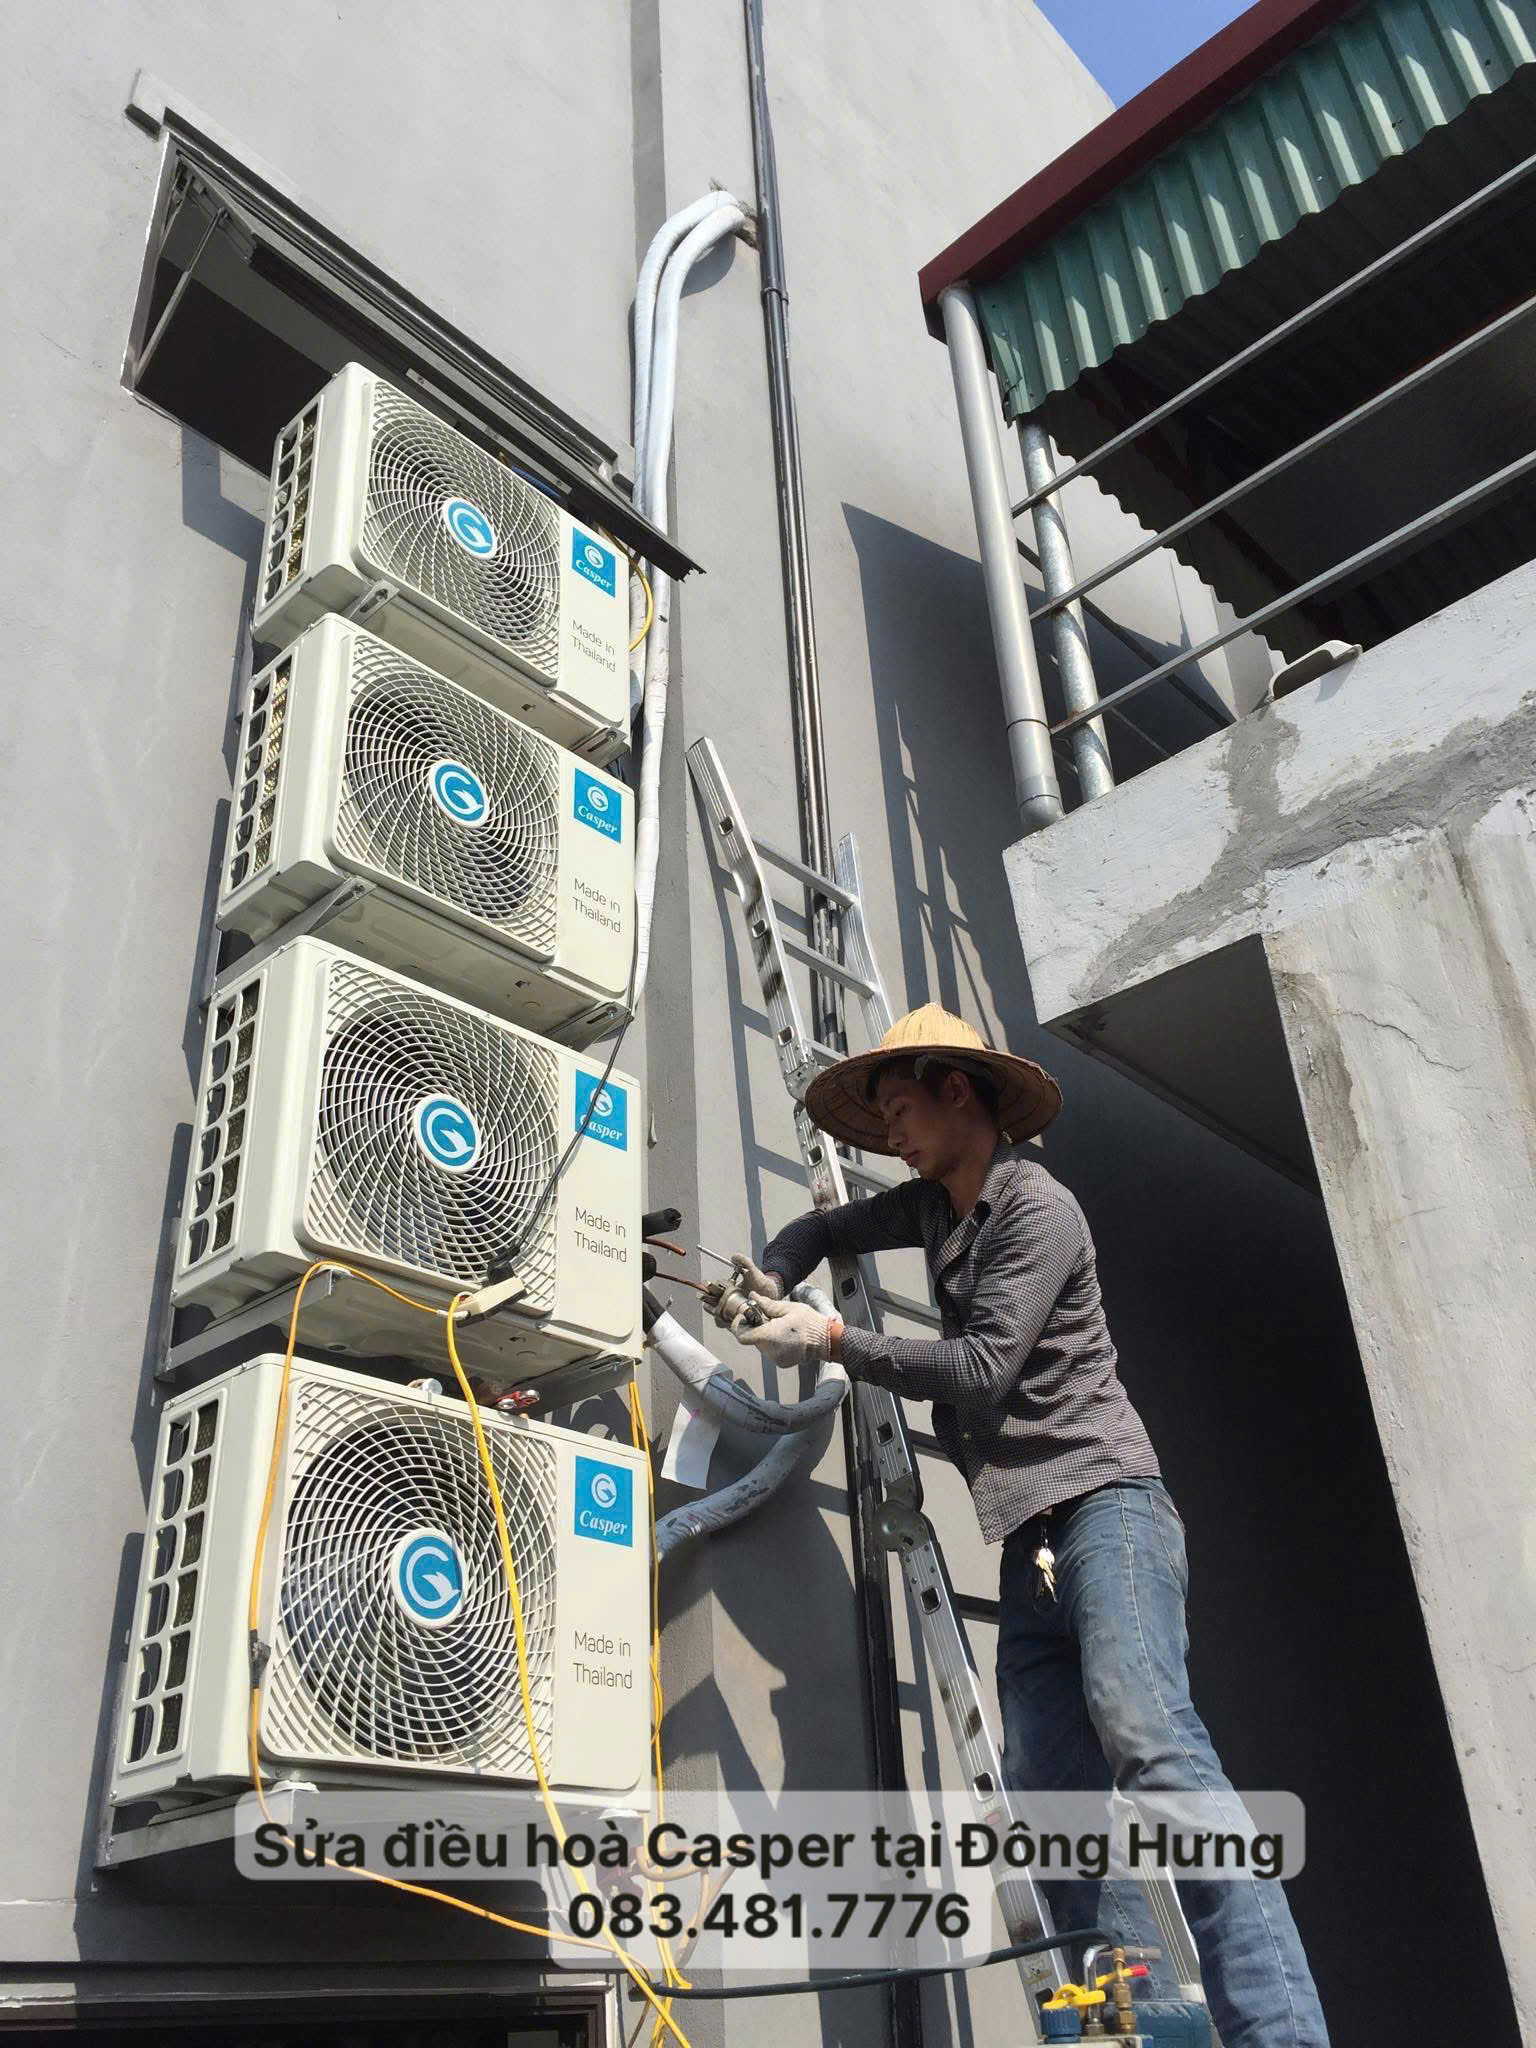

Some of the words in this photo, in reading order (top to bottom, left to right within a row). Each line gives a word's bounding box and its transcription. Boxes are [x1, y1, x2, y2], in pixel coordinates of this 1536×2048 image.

[575, 557, 612, 588] Casper
[572, 619, 602, 648] Made
[606, 643, 615, 654] in
[571, 635, 616, 673] Thailand
[578, 804, 617, 834] Casper
[574, 878, 607, 908] Made
[611, 898, 621, 913] in
[573, 897, 621, 933] Thailand
[575, 1206, 611, 1233] Made
[615, 1221, 626, 1238] in
[574, 1230, 627, 1263] Thailand
[580, 1510, 628, 1536] Casper
[574, 1631, 614, 1655] Made
[619, 1638, 631, 1657] in
[573, 1663, 633, 1690] Thailand
